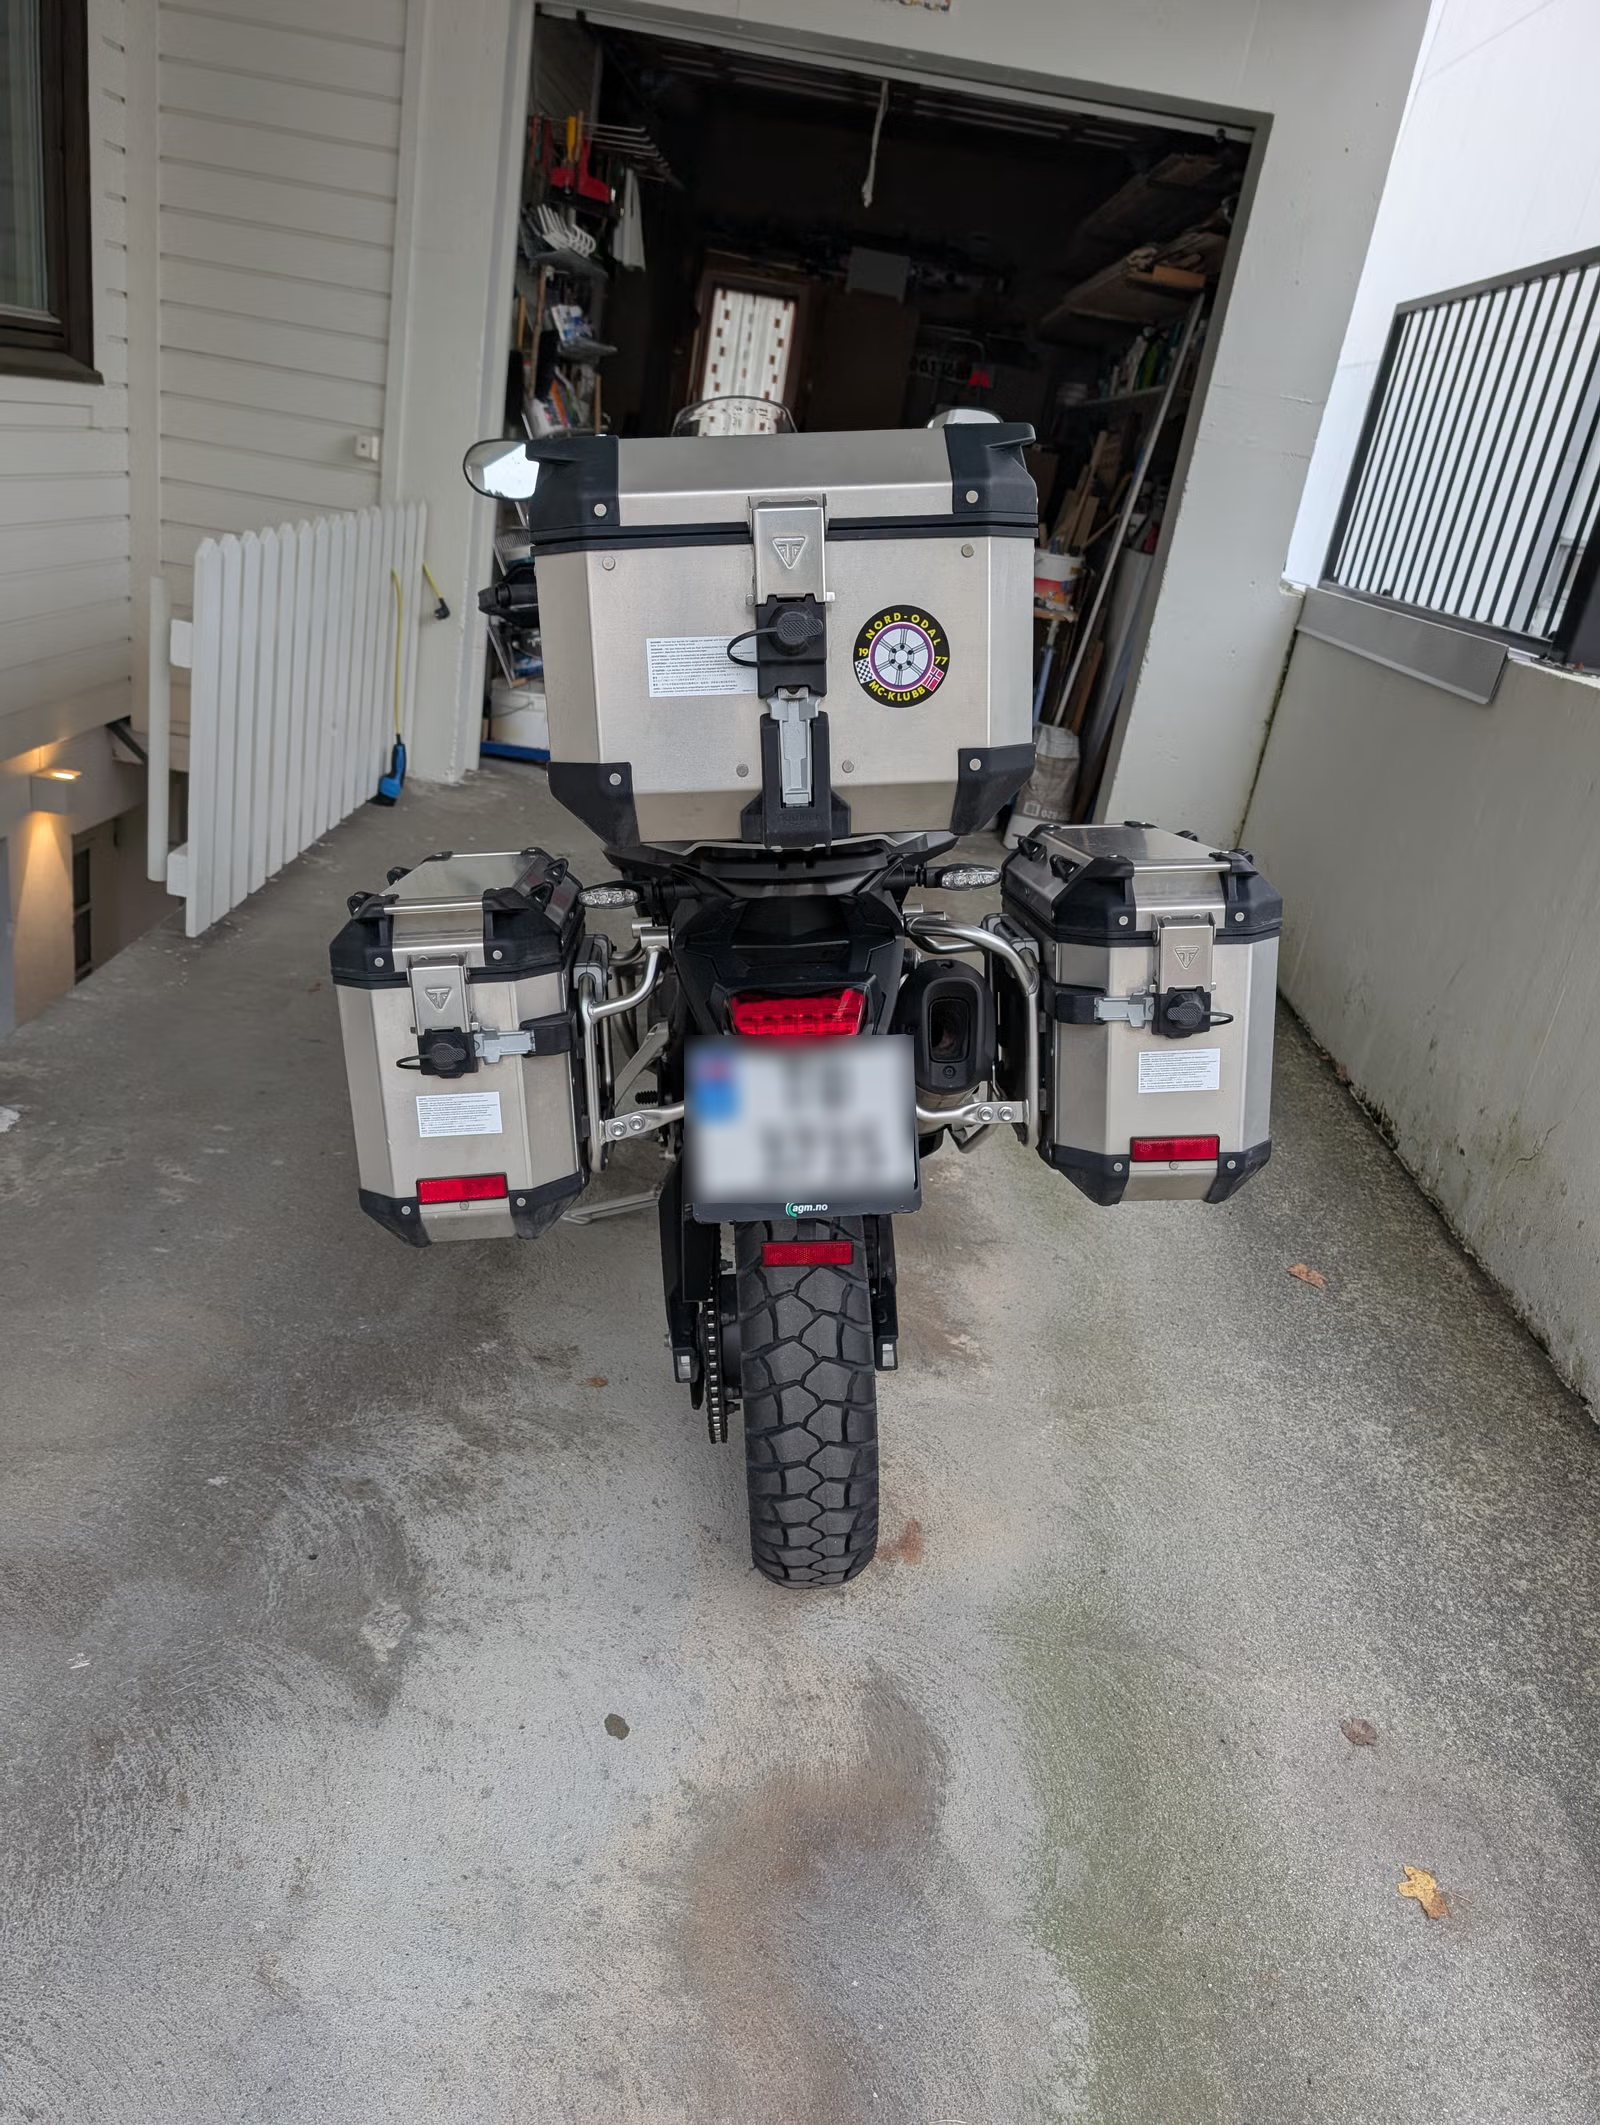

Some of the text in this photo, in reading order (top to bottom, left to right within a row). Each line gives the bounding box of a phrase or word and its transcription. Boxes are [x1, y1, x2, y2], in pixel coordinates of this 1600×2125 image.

[866, 612, 942, 646] NORD-ODAL
[858, 648, 949, 665] 19 77
[868, 680, 926, 702] MC-KLUBB
[792, 1203, 828, 1213] agm.no
